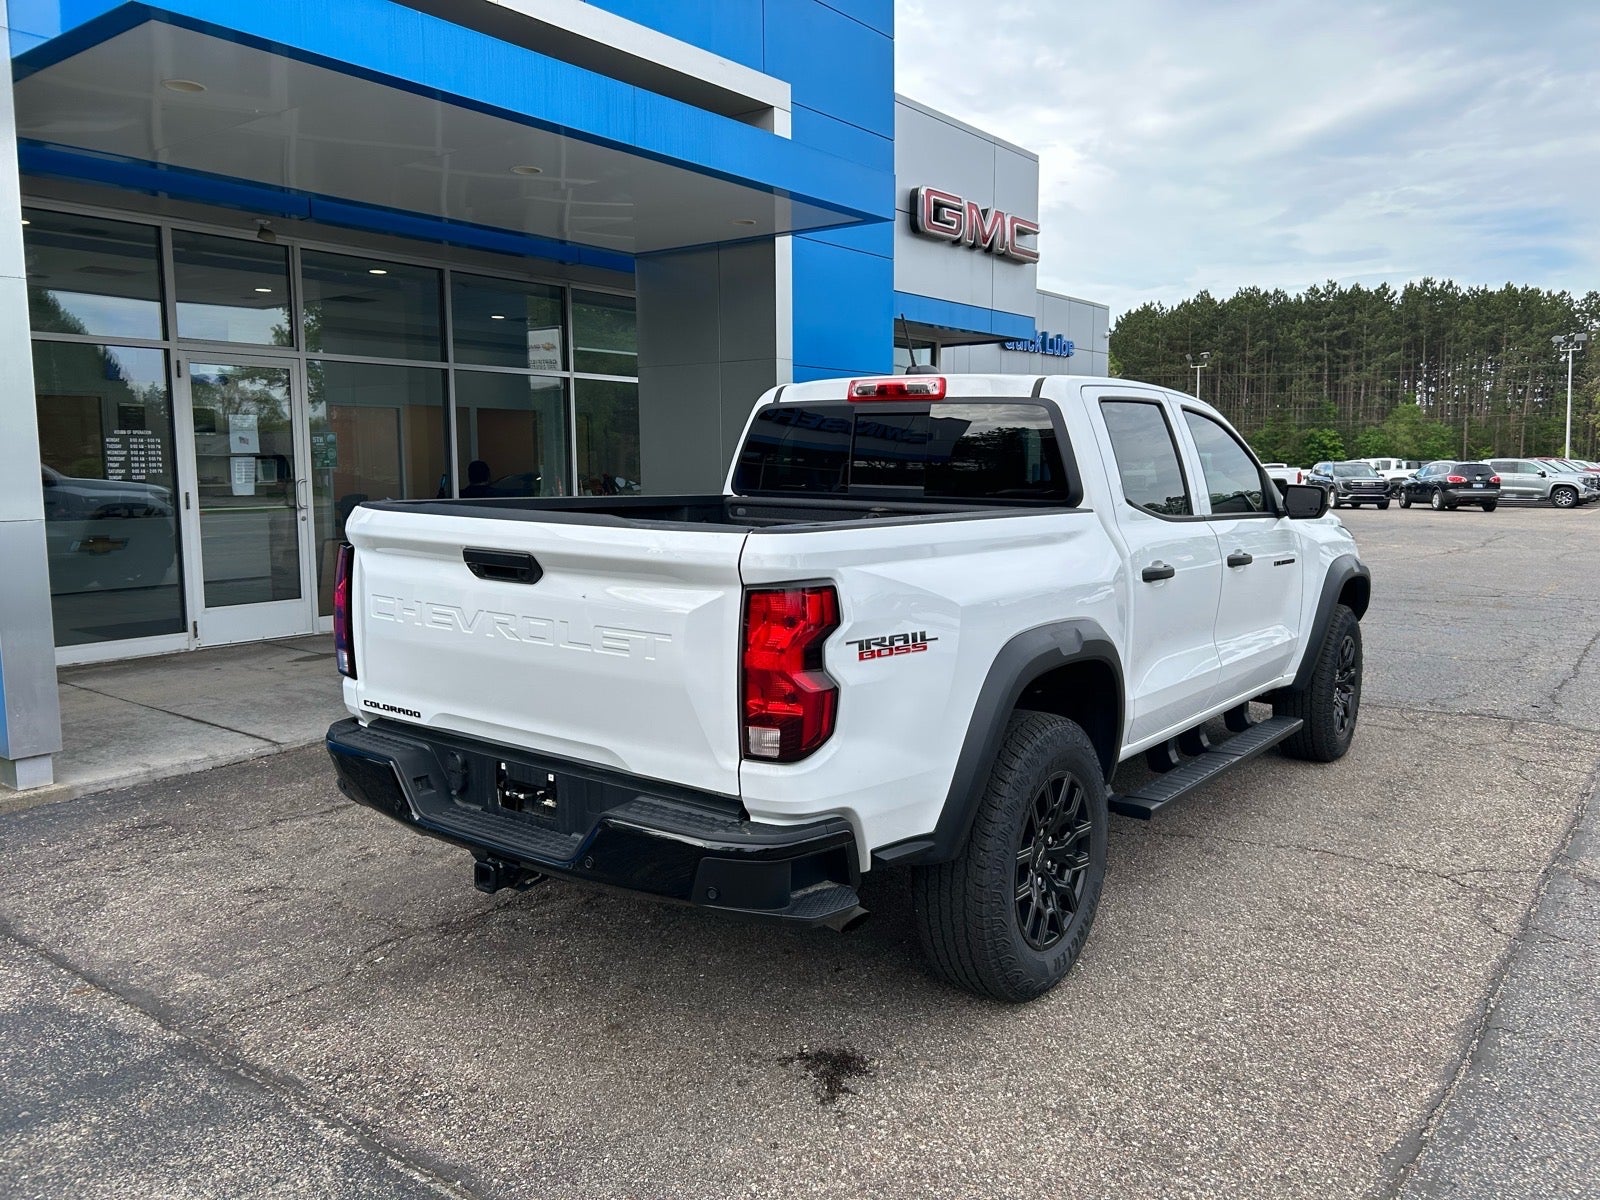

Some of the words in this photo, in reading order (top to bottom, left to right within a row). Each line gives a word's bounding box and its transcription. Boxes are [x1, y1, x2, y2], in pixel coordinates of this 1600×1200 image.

[910, 185, 1040, 263] GMC
[1044, 332, 1075, 357] Lube
[371, 593, 672, 661] CHEVROLET
[845, 631, 938, 651] TRAIL
[858, 642, 928, 661] BOSS
[363, 699, 422, 719] COLORADO
[1053, 882, 1101, 974] WRANGLER
